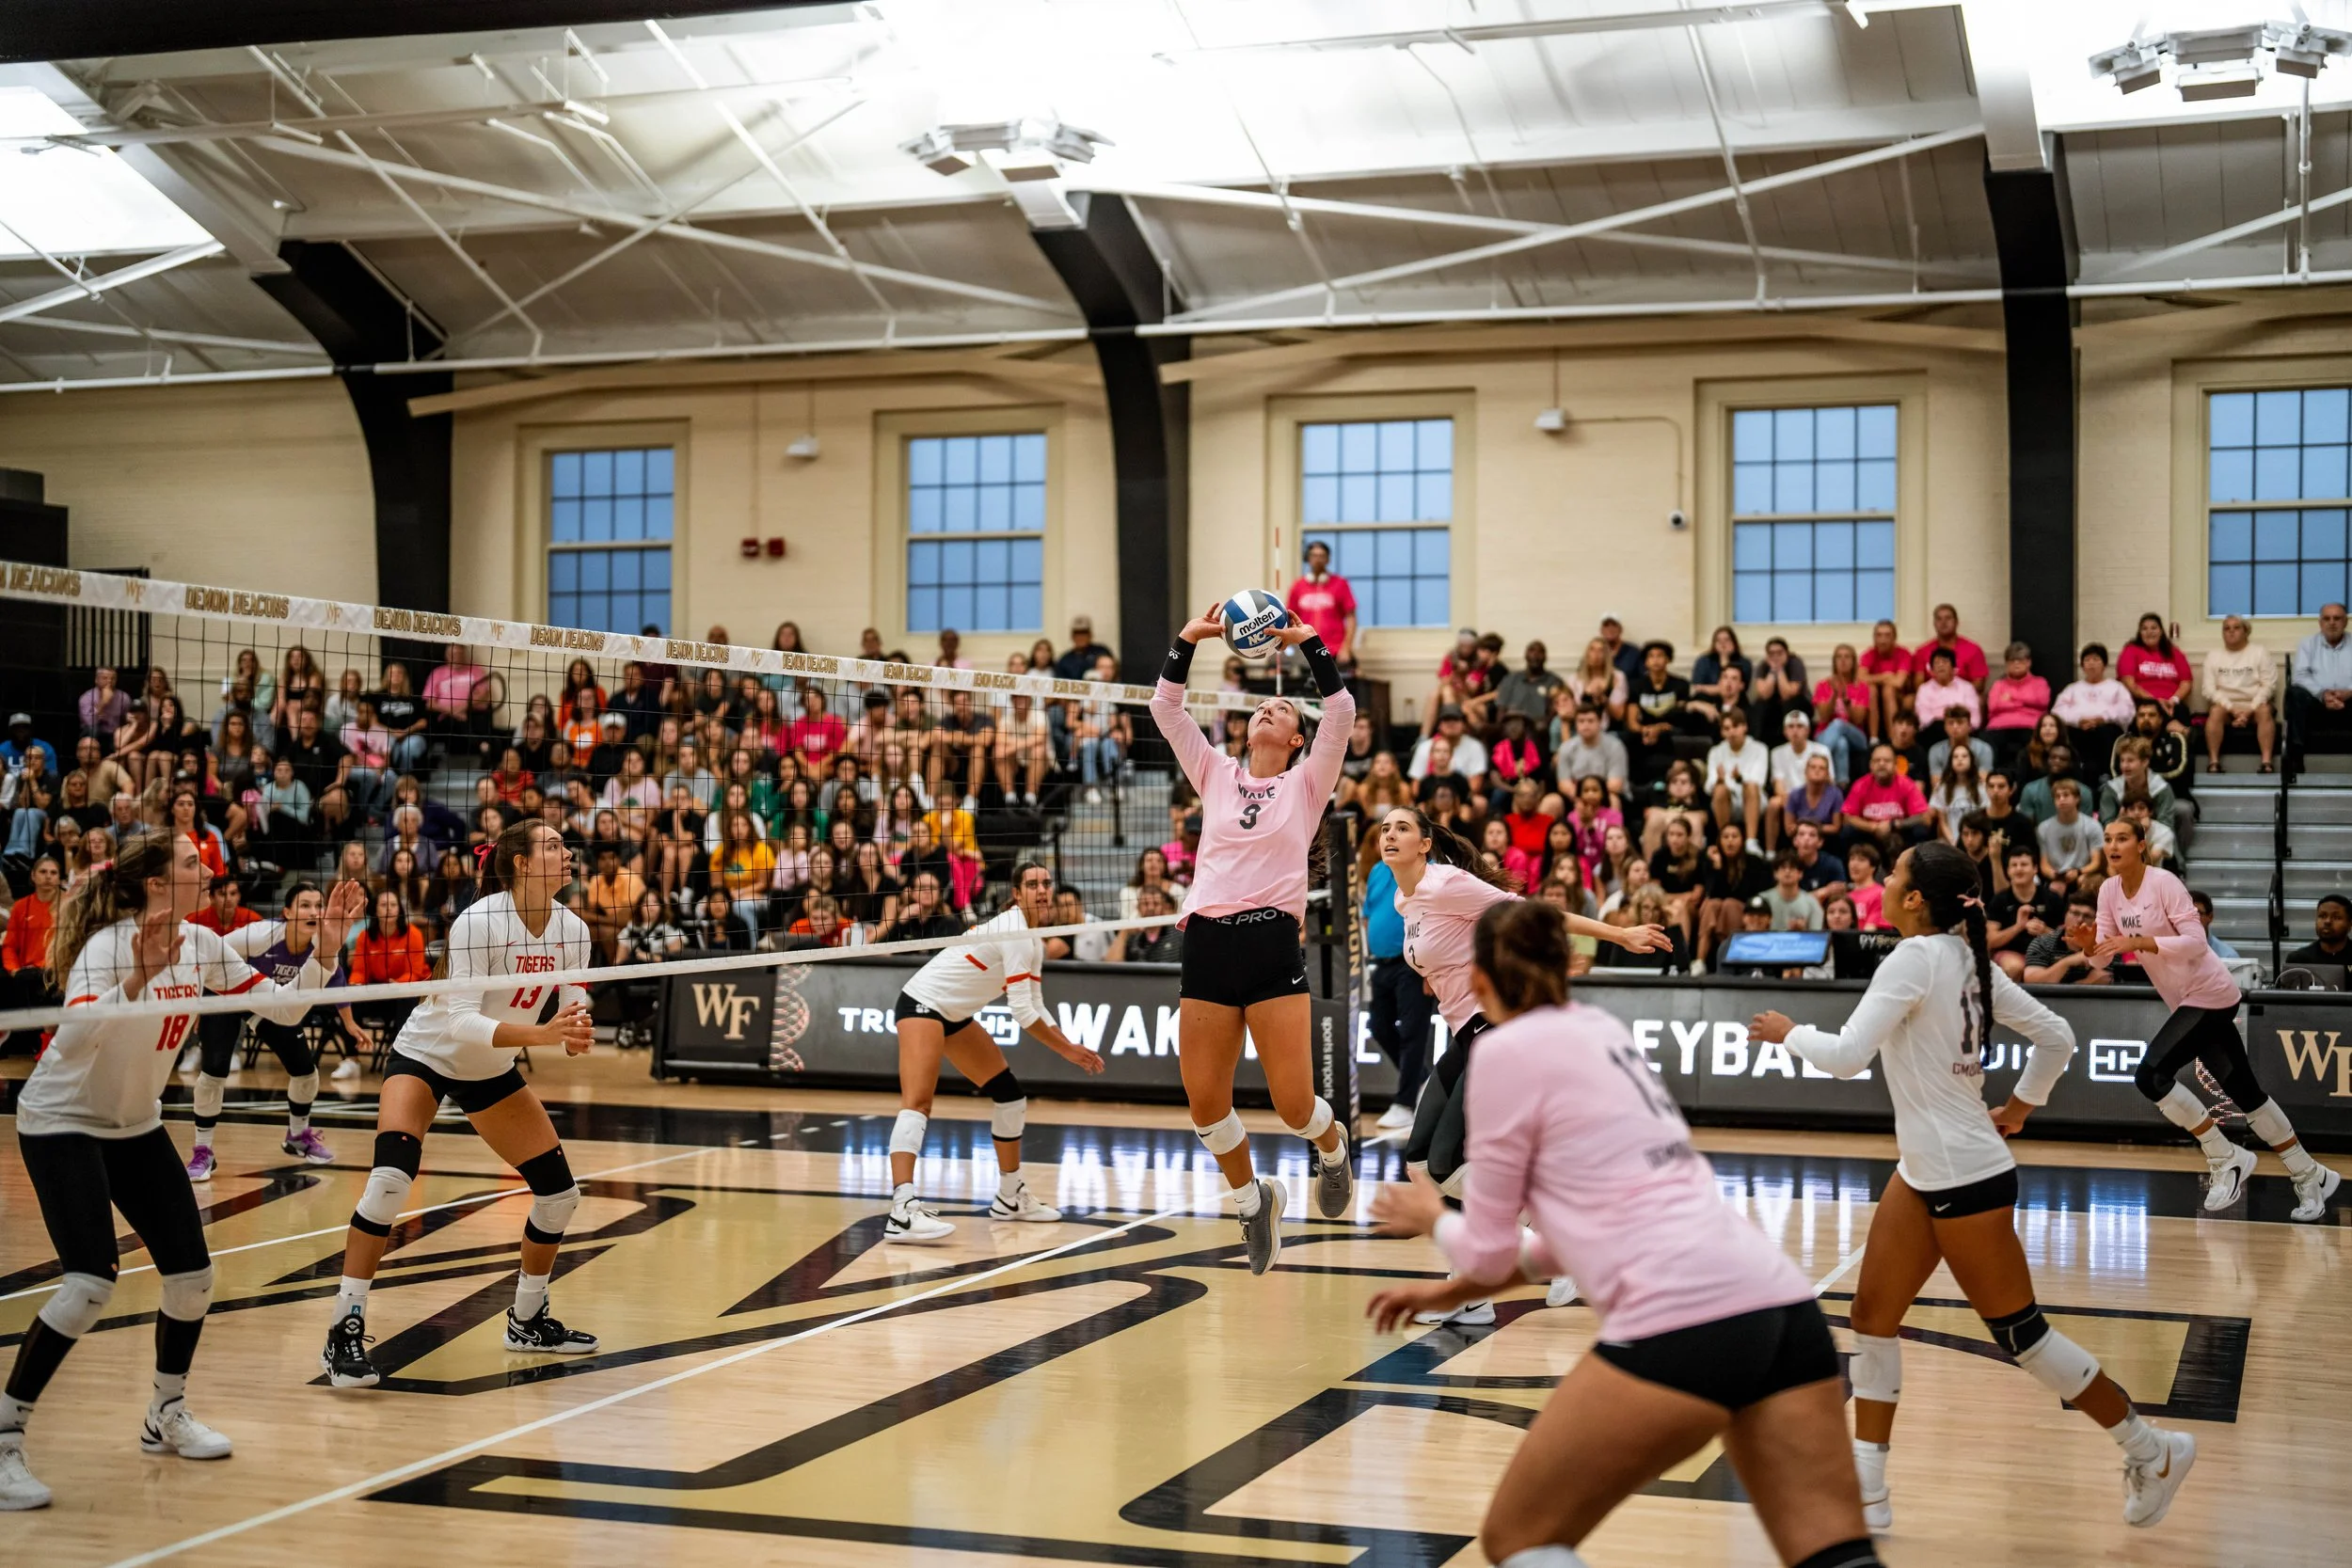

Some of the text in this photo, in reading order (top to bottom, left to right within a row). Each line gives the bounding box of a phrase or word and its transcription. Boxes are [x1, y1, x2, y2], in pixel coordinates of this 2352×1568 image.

[9, 564, 81, 596] DEACONS
[184, 585, 289, 619] DEMON DEACONS
[373, 606, 462, 637] DEMON DEACONS
[1239, 611, 1276, 635] molten
[530, 626, 605, 652] DEMON DEACONS
[1248, 624, 1276, 646] NC
[665, 640, 730, 664] DEMON DEACONS
[1235, 909, 1278, 926] PRO
[2122, 914, 2142, 928] WAKE
[274, 963, 299, 976] TIGER
[516, 956, 556, 974] TIGERS
[153, 984, 199, 1001] TIGERS
[509, 986, 544, 1009] 13
[691, 983, 760, 1040] WF
[838, 1006, 898, 1034] TRU
[155, 1014, 190, 1052] 18
[1057, 1002, 1181, 1055] WAK
[1321, 1016, 1334, 1099] sports imports
